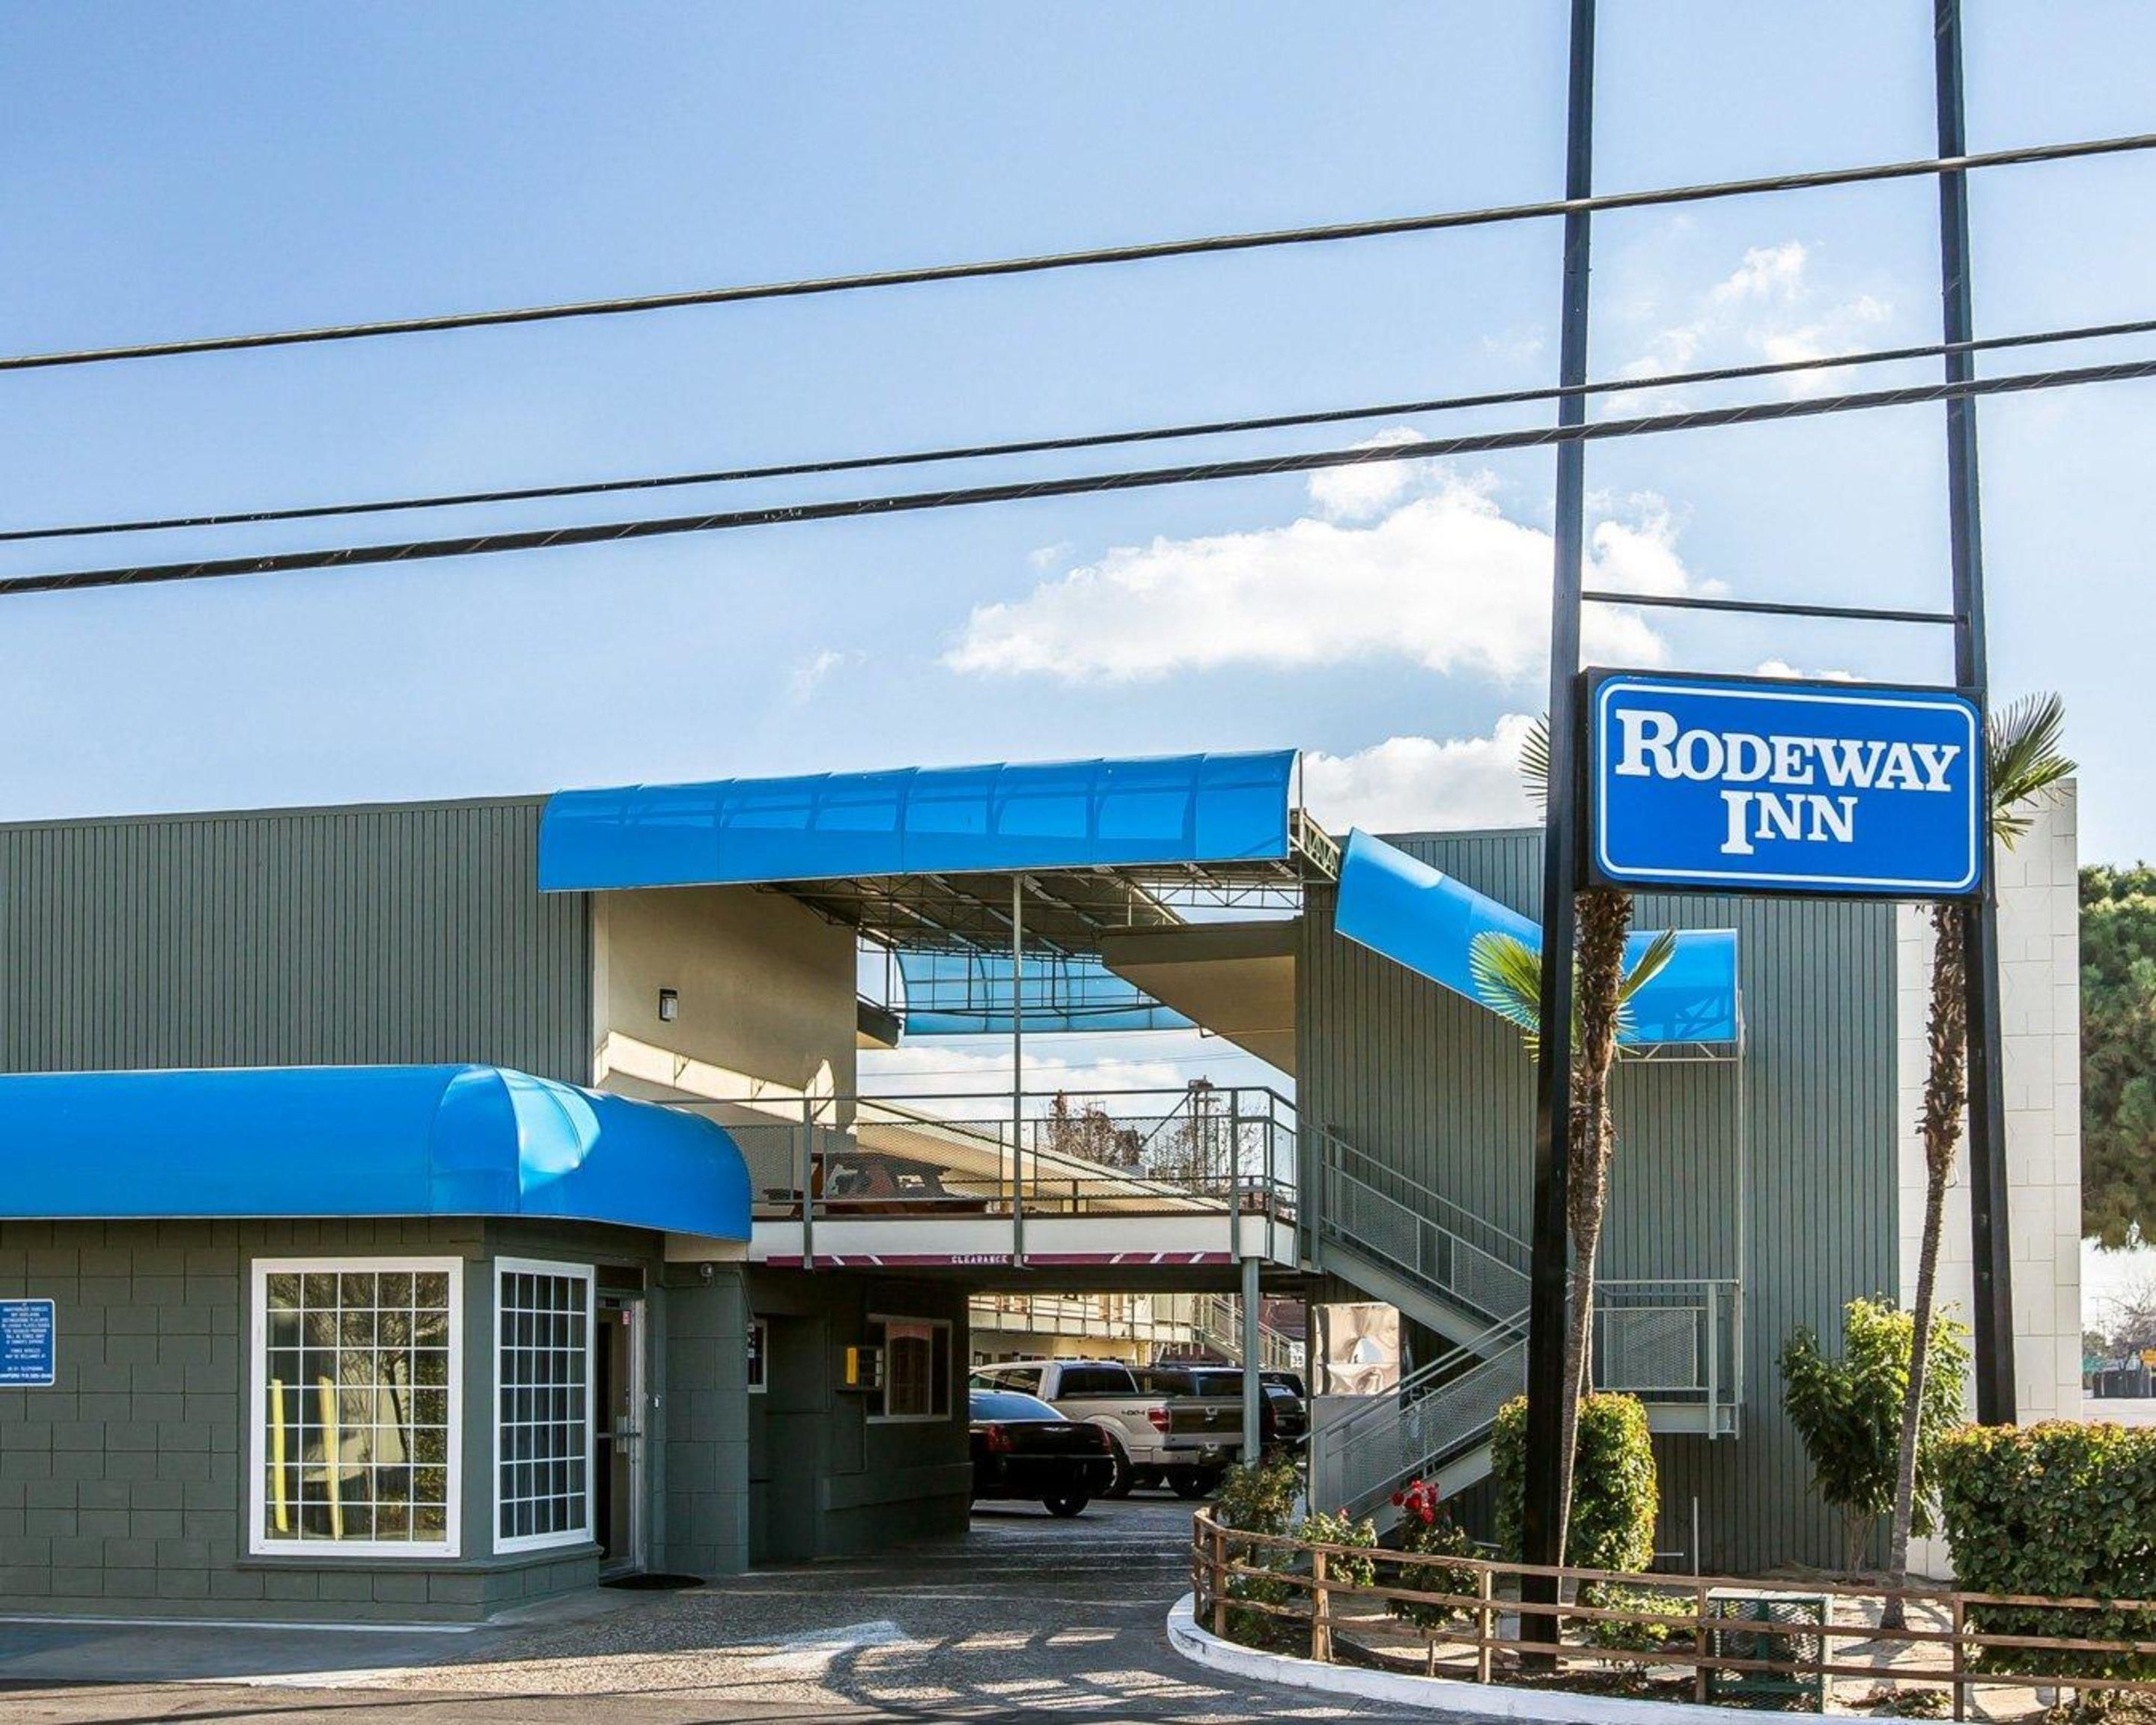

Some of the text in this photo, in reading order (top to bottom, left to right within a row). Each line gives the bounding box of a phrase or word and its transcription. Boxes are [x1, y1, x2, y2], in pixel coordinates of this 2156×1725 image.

[1616, 708, 1960, 791] RODEWAY
[1721, 790, 1858, 855] INN
[951, 1254, 1007, 1265] CLEARANCE
